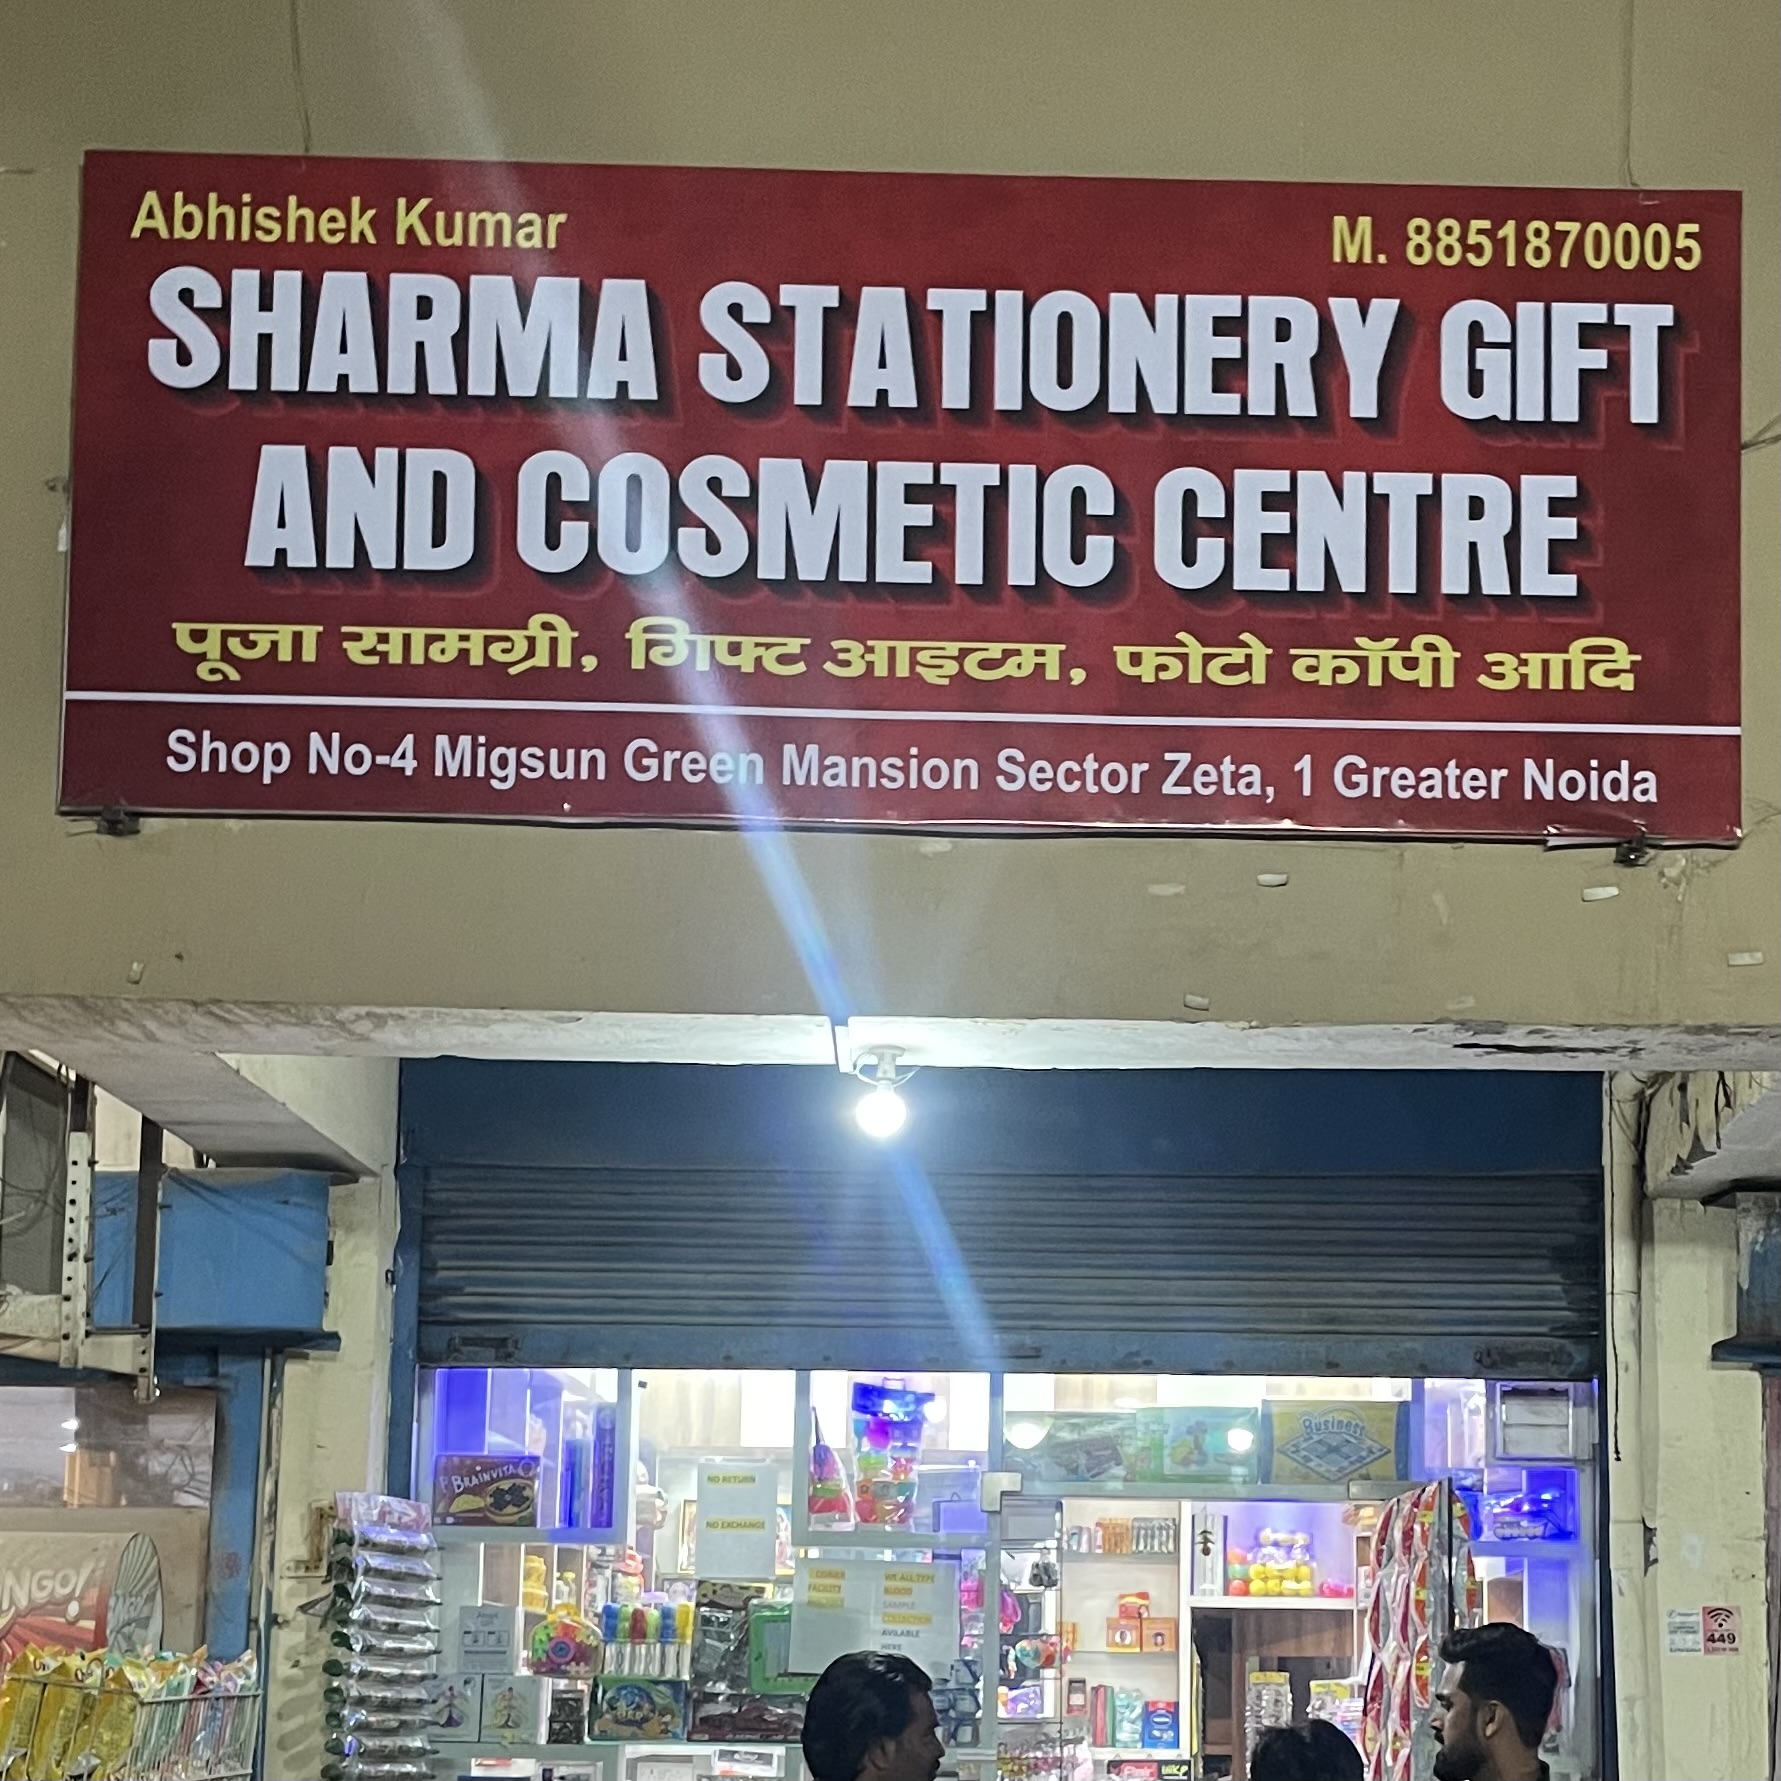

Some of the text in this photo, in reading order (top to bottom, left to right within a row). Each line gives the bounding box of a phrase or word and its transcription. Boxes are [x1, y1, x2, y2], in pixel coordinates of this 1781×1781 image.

[131, 191, 567, 249] Abhishek Kumar
[1333, 215, 1701, 271] M. 8851870005
[147, 266, 1675, 424] SHARMA STATIONERY GIFT
[244, 445, 1579, 597] AND COSMETIC CENTRE
[172, 614, 1642, 691] पूजा सामग्री, गिफ्ट आइटम, फोटो कॉपी आदि
[167, 728, 1659, 805] Shop No-4 Migsun Green Mansion Sector Zeta, 1 Greater Noida
[1301, 1416, 1366, 1437] Business
[706, 1520, 766, 1529] NO EXCHANGE
[0, 1558, 95, 1623] NGO!
[1706, 1632, 1736, 1645] 449
